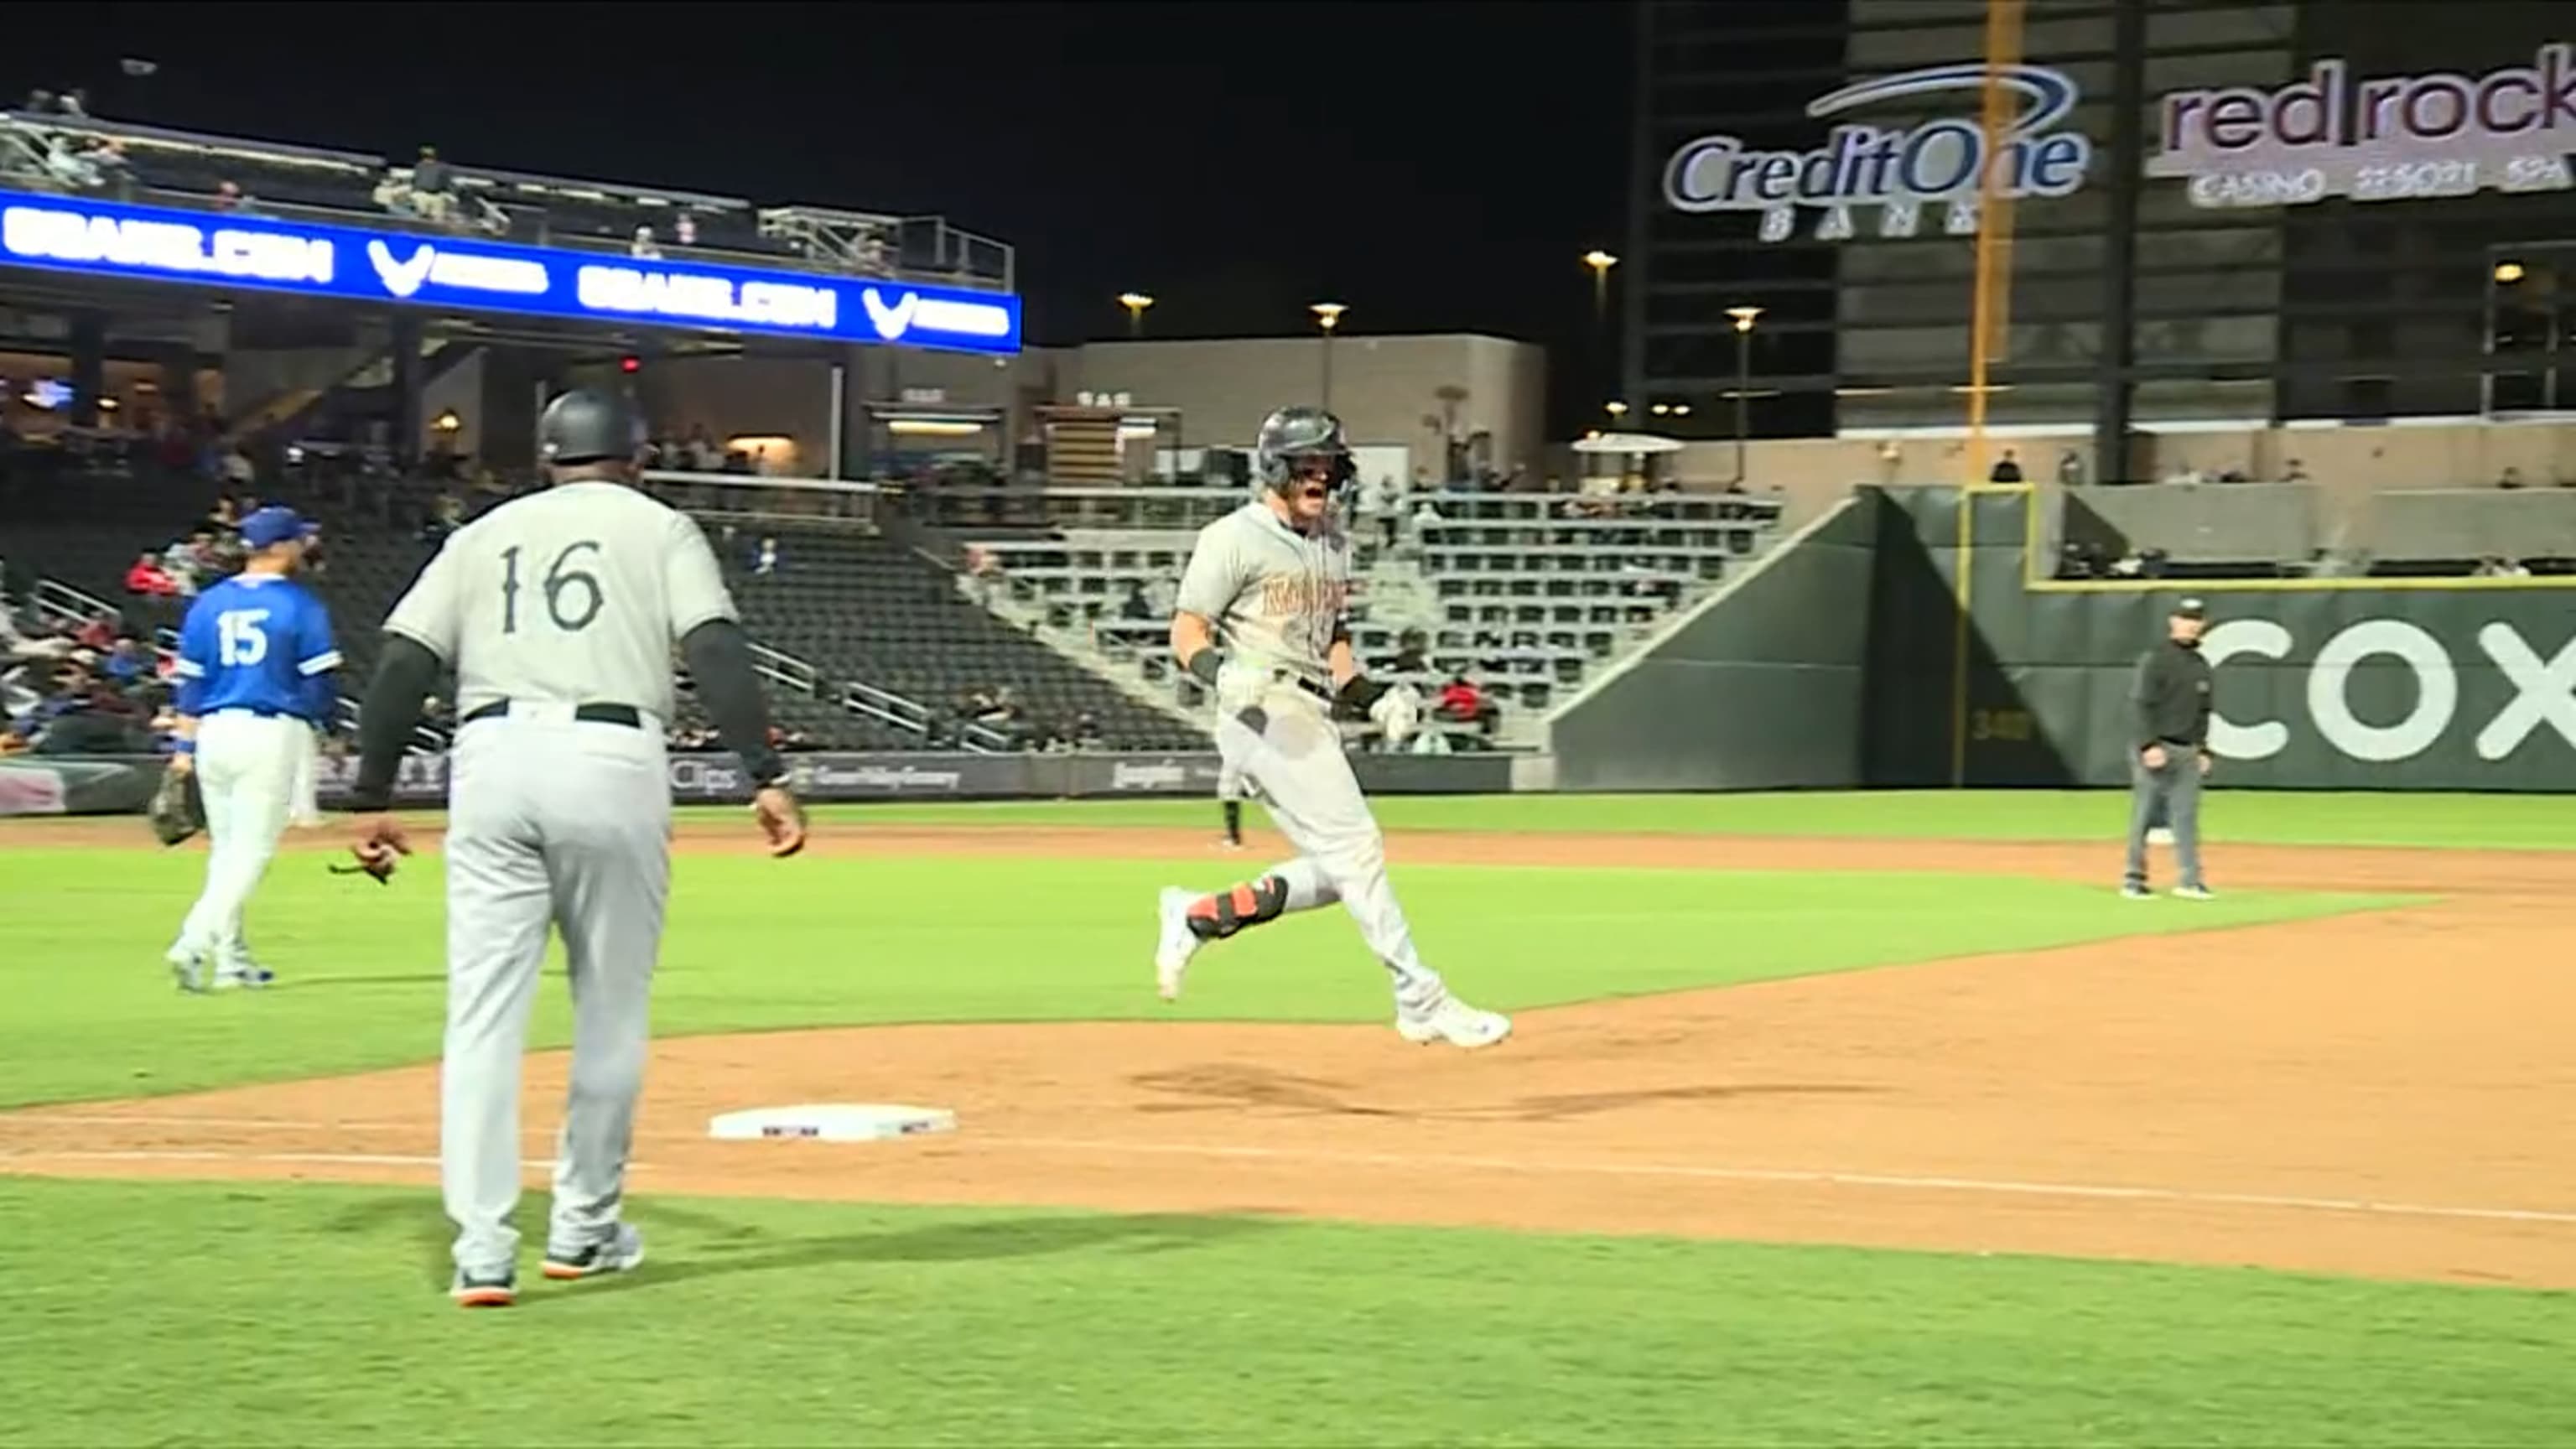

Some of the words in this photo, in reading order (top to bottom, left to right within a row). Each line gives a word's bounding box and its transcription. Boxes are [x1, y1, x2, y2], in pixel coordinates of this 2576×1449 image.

[2169, 65, 2330, 151] red
[2366, 50, 2576, 140] rock
[1758, 206, 1981, 244] BANK
[499, 540, 604, 634] 16
[217, 610, 268, 667] 15
